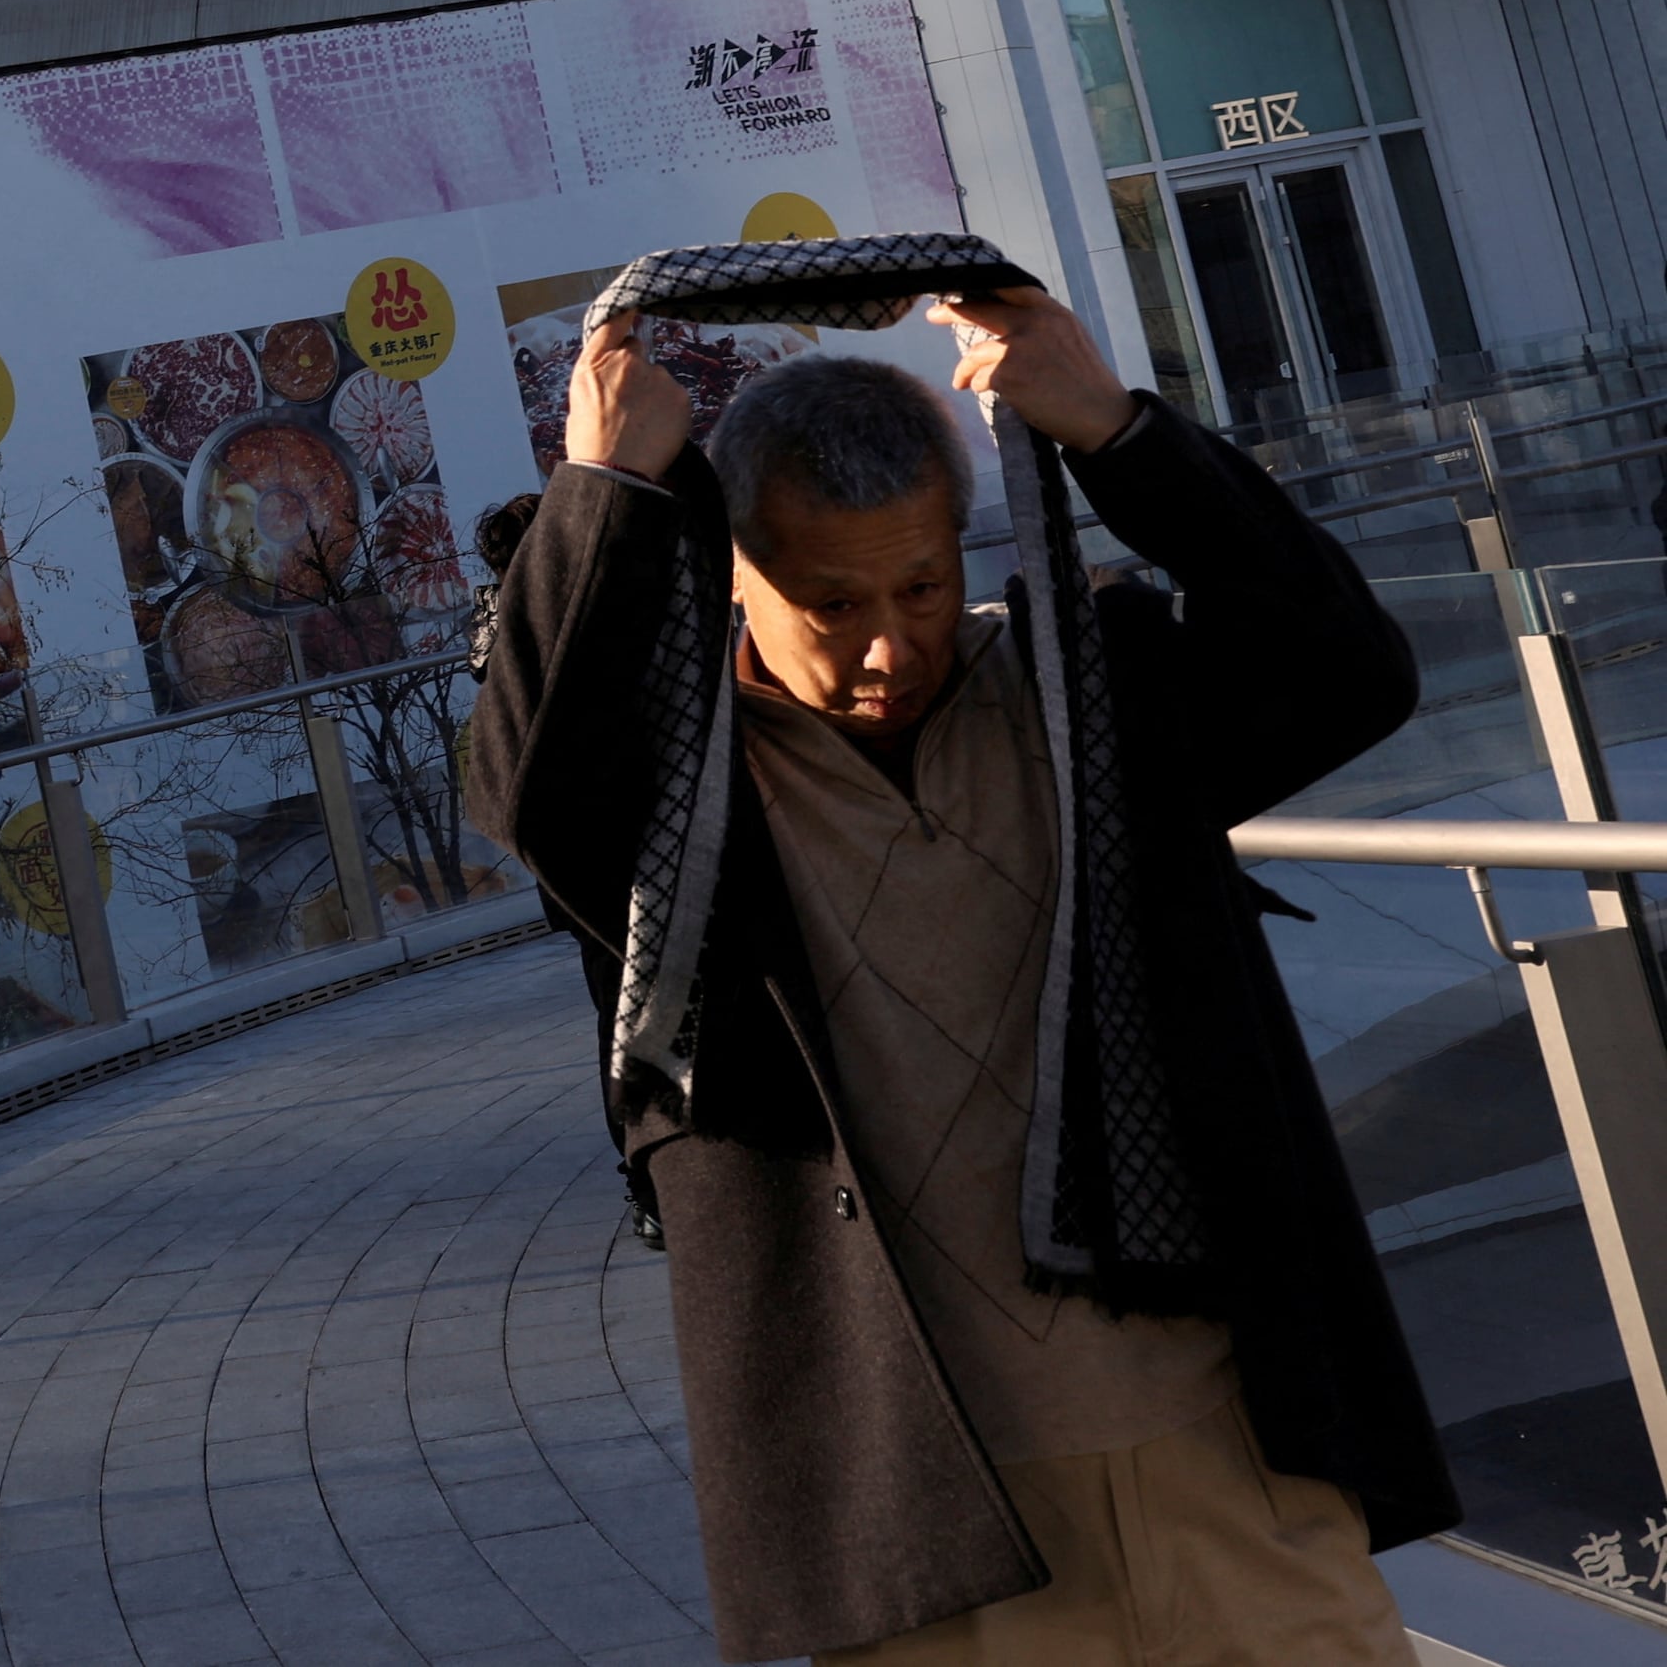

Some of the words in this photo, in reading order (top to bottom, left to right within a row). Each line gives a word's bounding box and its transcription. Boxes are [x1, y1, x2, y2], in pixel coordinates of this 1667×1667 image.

[712, 85, 761, 105] LET'S
[724, 95, 802, 120] FASHION
[741, 107, 831, 134] FORWARD
[1211, 91, 1309, 150] 西区
[371, 268, 427, 332] 怂
[370, 332, 441, 357] 重庆火锅厂
